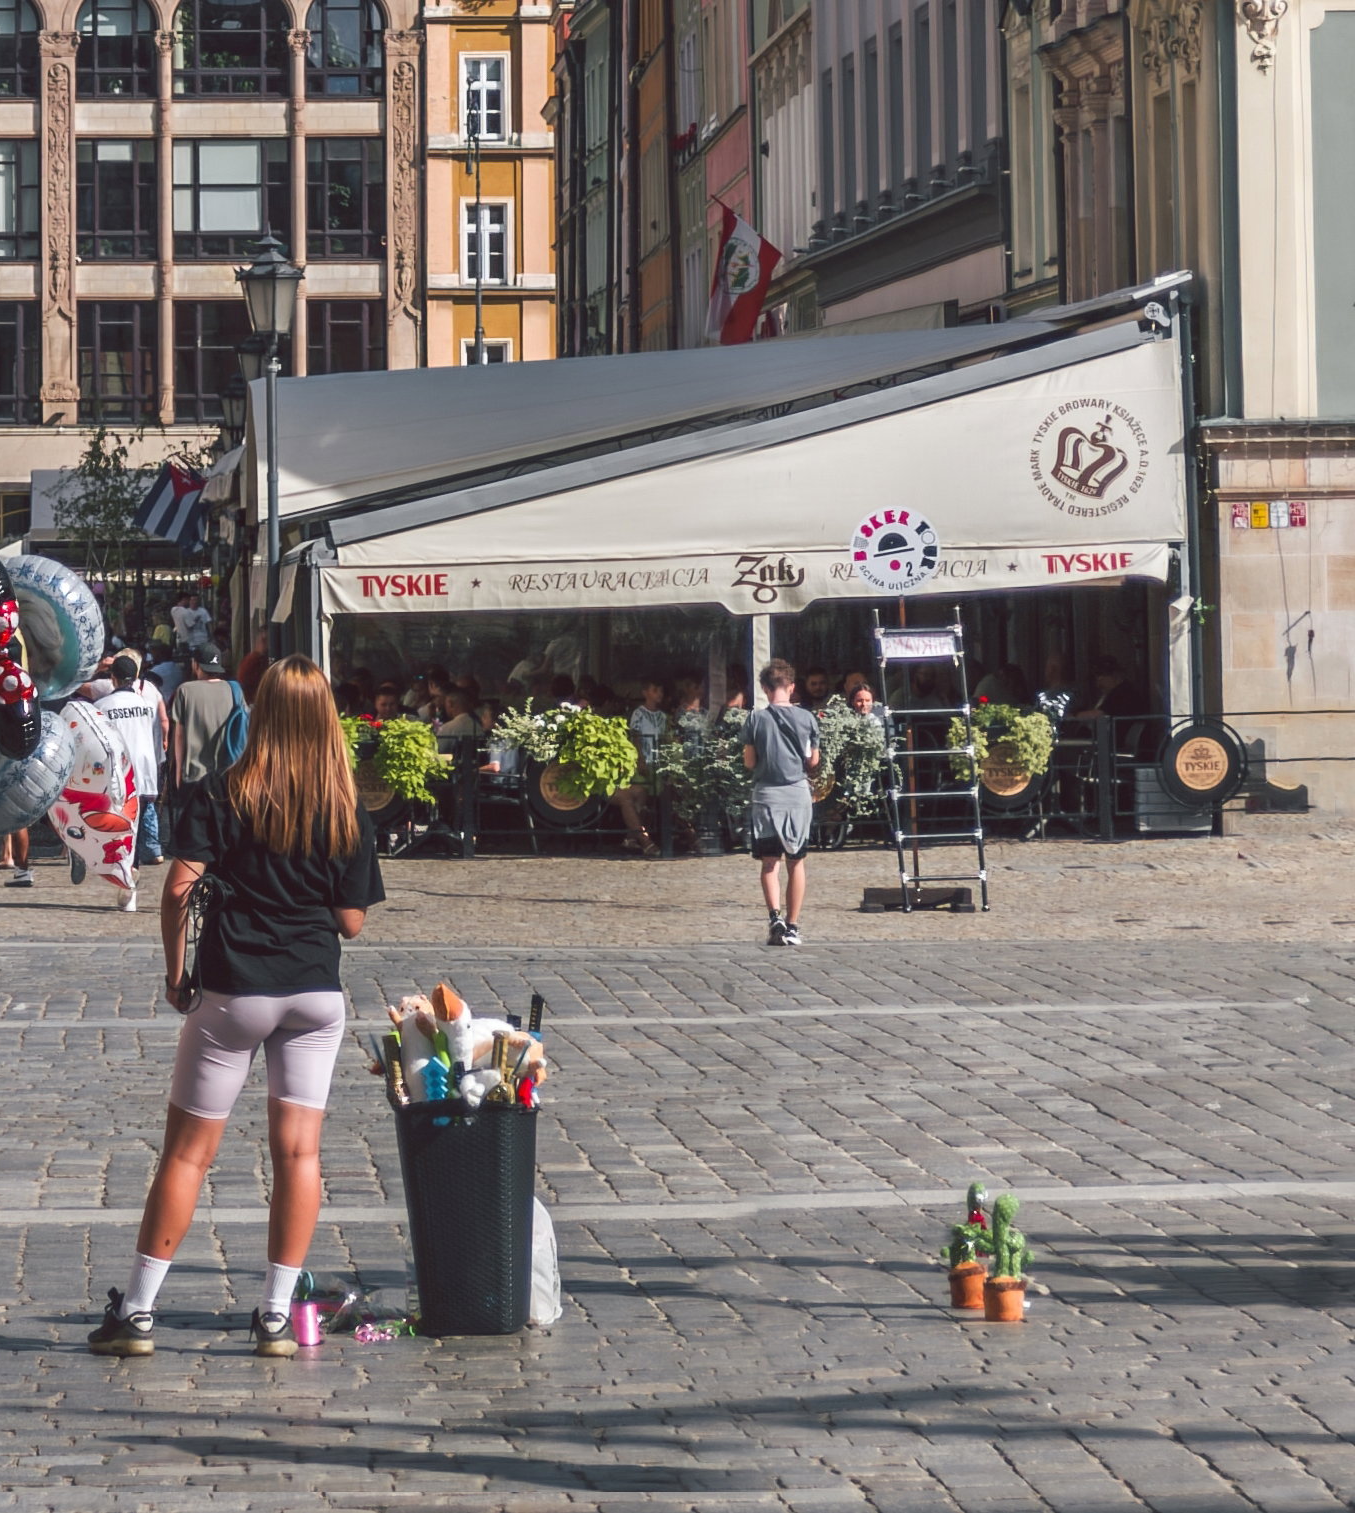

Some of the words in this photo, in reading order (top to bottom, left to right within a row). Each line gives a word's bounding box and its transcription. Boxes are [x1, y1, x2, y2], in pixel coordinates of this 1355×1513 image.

[1058, 398, 1112, 416] BROWARY
[1033, 411, 1059, 443] TYSKIE
[1029, 449, 1043, 481] MARK
[1037, 481, 1066, 511] TRADE
[1067, 494, 1130, 518] REGISTERED
[906, 561, 913, 577] 2
[1041, 553, 1134, 574] TYSKIE
[357, 574, 449, 597] TYSKIE
[859, 565, 885, 588] SCENA
[1184, 761, 1221, 771] TYSKIE
